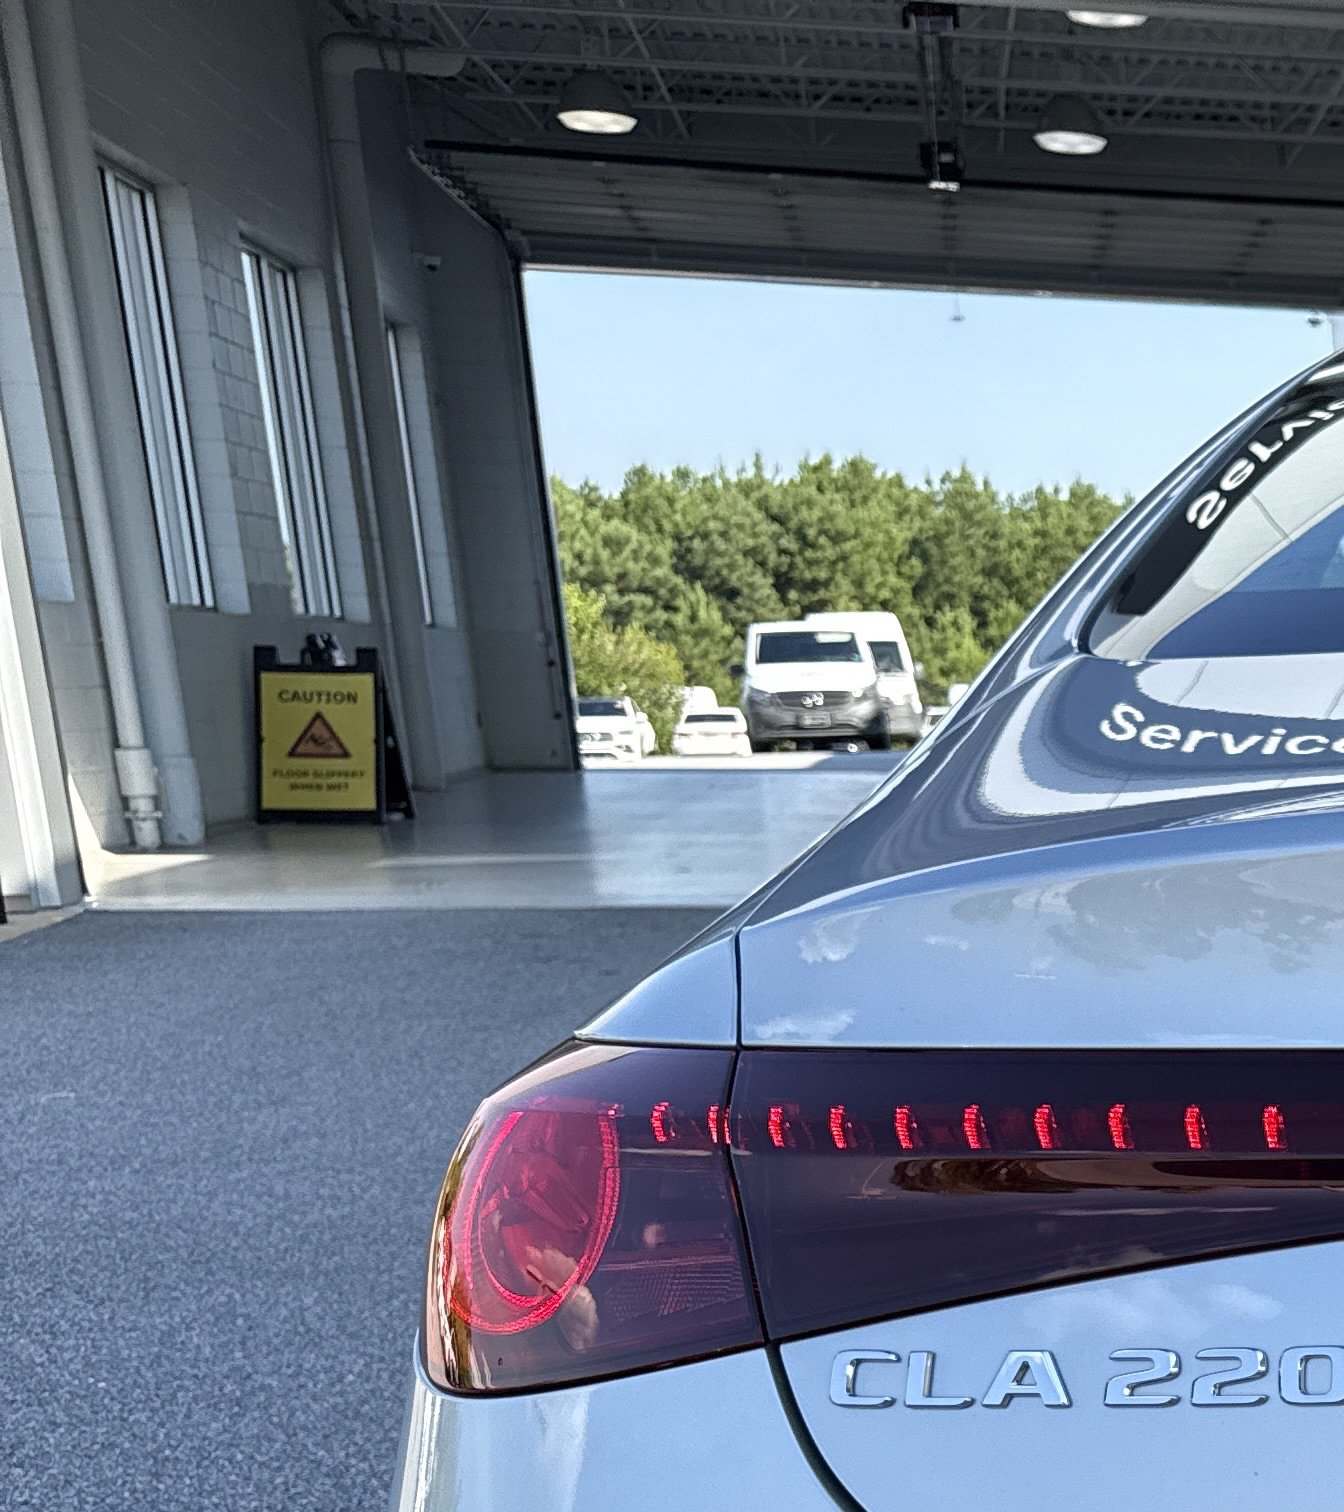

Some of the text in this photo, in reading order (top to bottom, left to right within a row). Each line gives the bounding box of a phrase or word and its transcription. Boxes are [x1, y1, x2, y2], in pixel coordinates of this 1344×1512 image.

[277, 689, 359, 704] CAUTION
[272, 768, 310, 778] FLOOR
[326, 782, 350, 791] WET
[829, 1348, 1073, 1409] CLA
